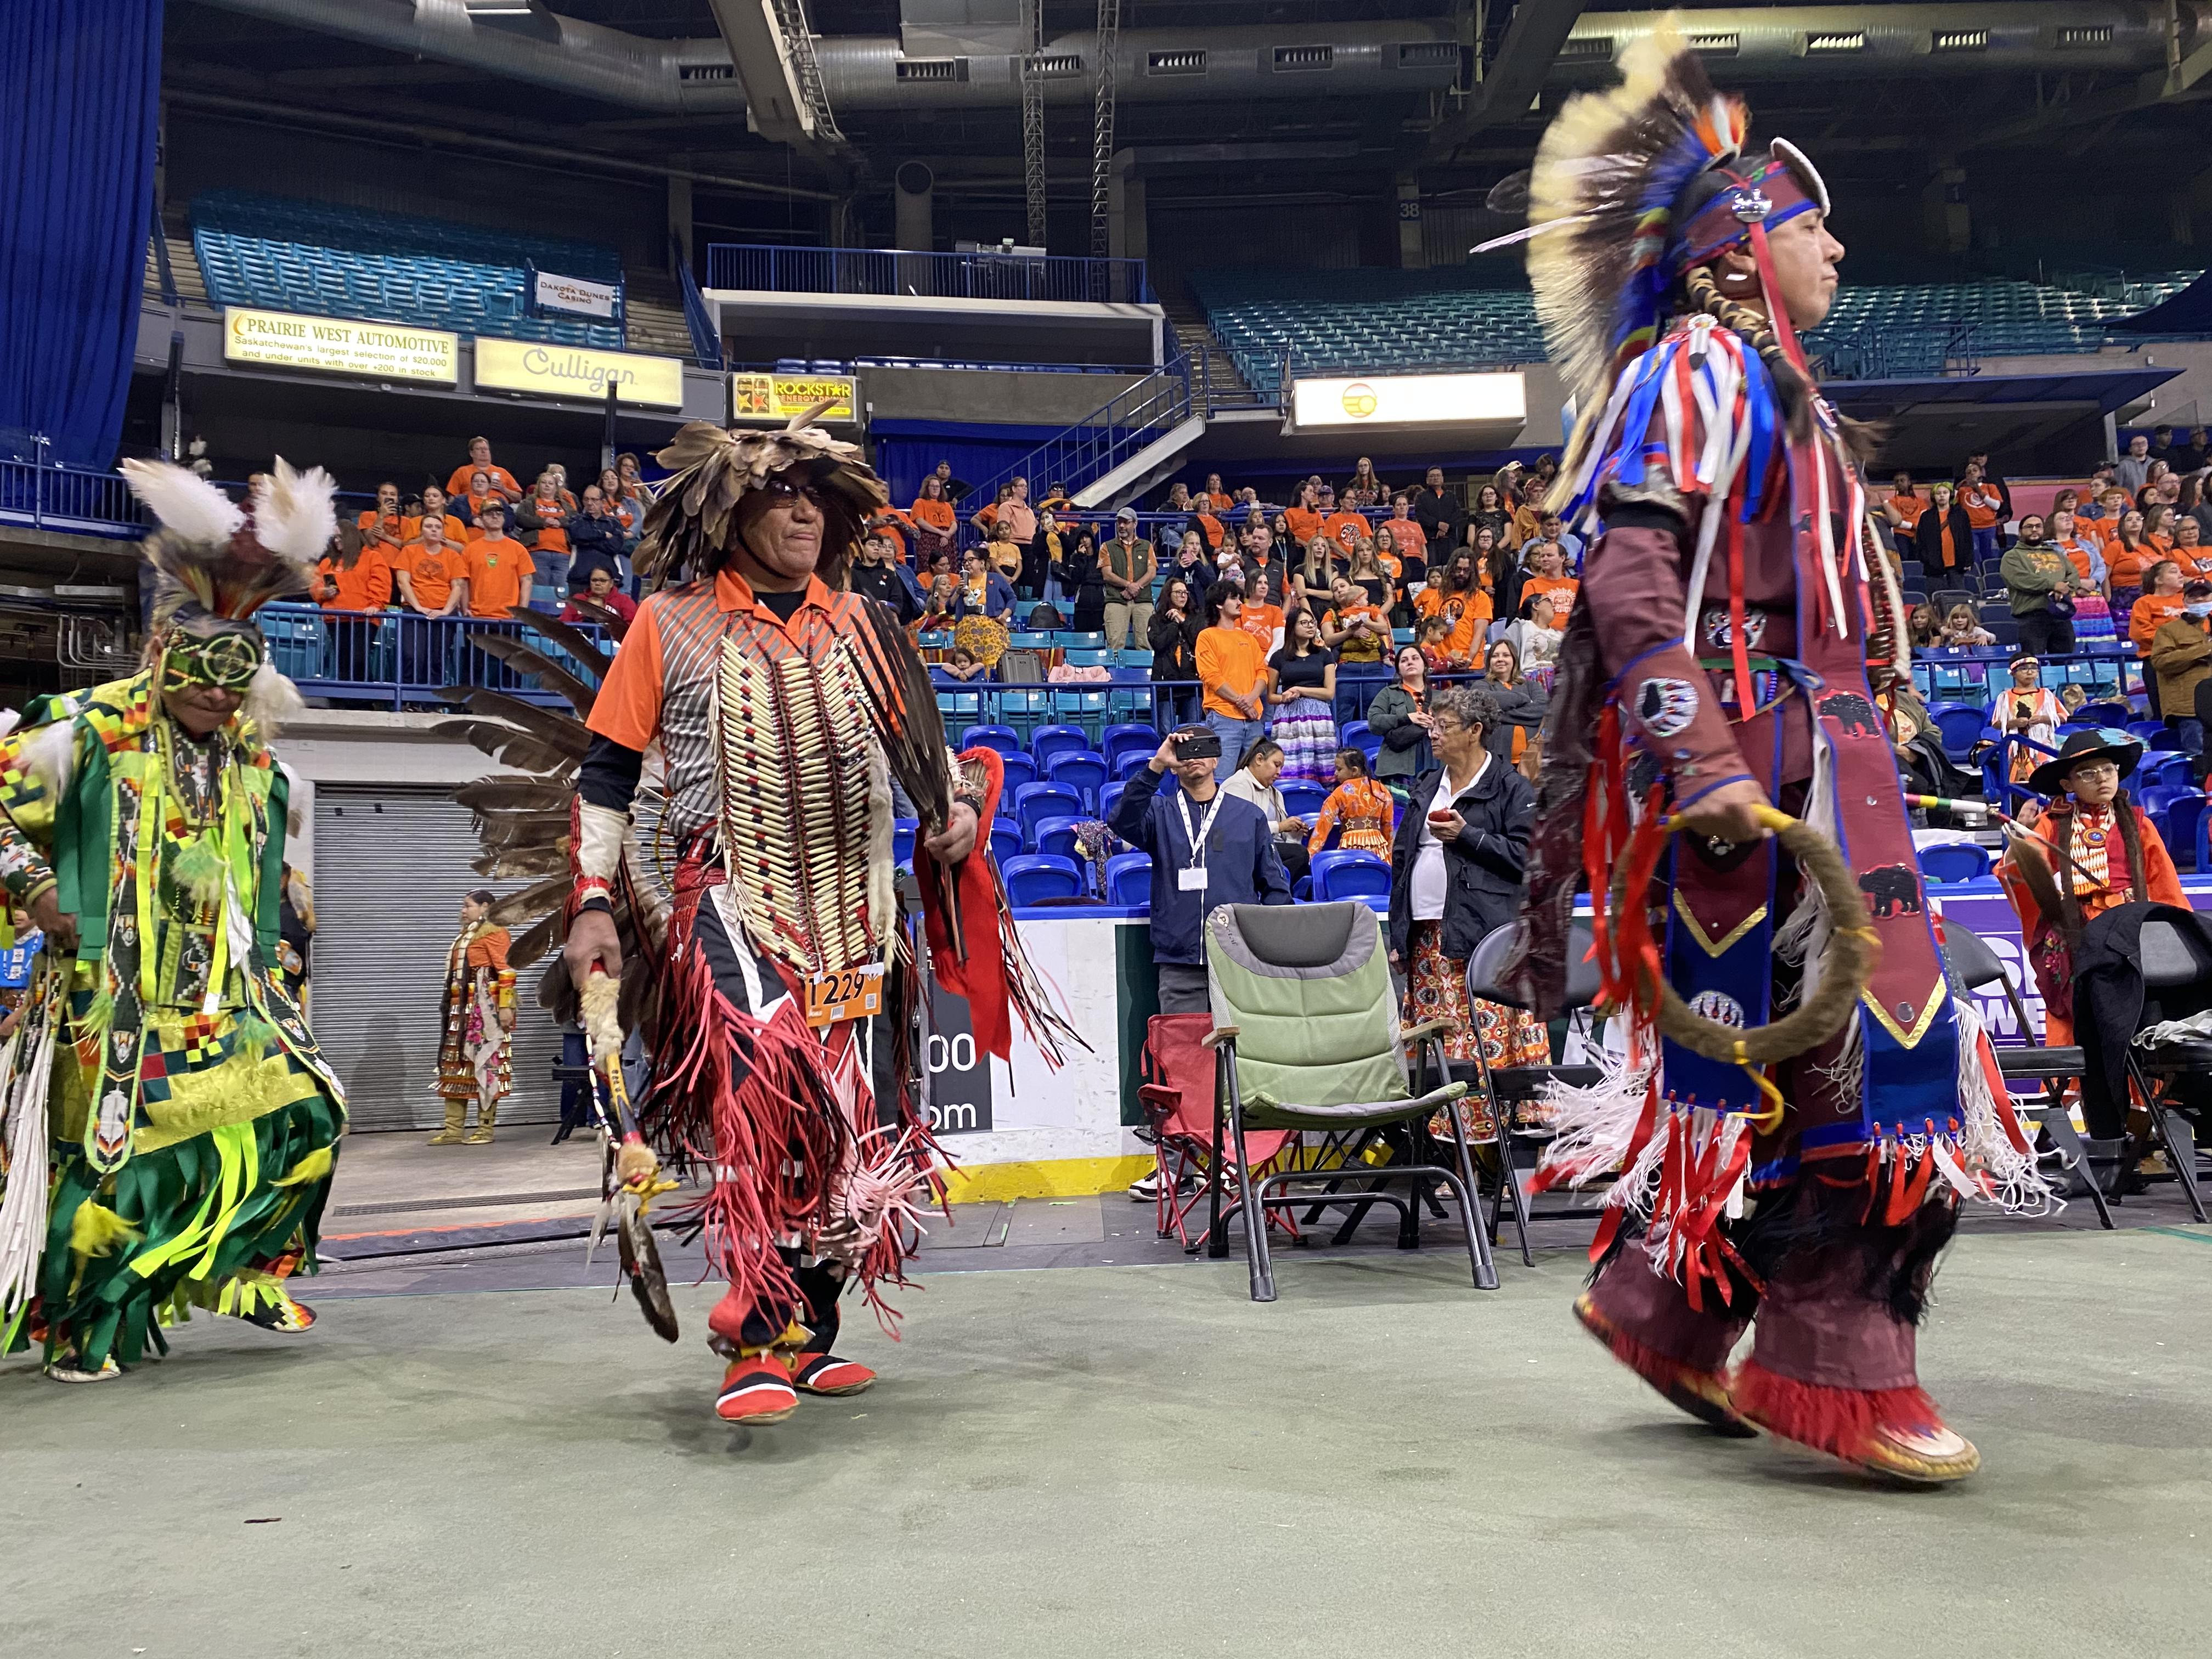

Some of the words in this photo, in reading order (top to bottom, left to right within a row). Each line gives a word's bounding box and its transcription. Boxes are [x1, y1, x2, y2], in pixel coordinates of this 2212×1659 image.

[1400, 203, 1419, 217] 38
[540, 281, 576, 294] DAKOTA
[579, 289, 610, 301] DUNES
[558, 292, 592, 304] CASINO
[247, 318, 306, 337] PRAIRIE
[312, 326, 351, 343] WEST
[357, 331, 449, 354] AUTOMOTIVE
[235, 336, 312, 352] Saskatchewan's
[317, 345, 349, 357] largest
[354, 351, 396, 361] selection
[266, 353, 293, 361] under
[298, 357, 320, 365] units
[325, 359, 344, 367] with
[374, 364, 394, 373] +200
[411, 368, 436, 377] stock
[523, 348, 635, 392] Culligan
[781, 394, 816, 403] ENERGY
